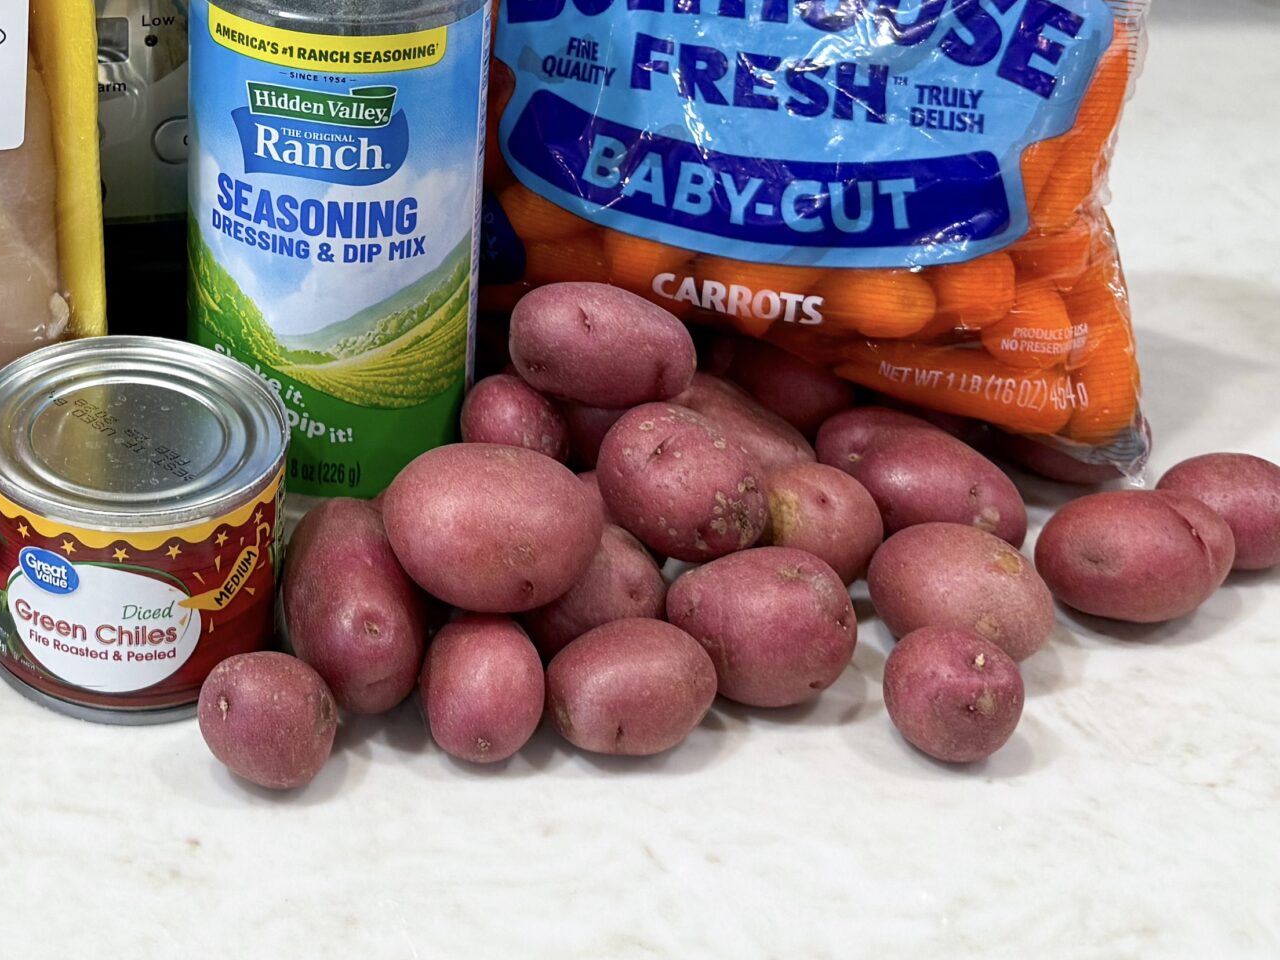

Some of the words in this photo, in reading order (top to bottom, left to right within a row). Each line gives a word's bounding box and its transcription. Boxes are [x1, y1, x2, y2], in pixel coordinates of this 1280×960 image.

[141, 15, 175, 27] Low
[215, 22, 279, 55] AMERICA'S
[281, 45, 294, 58] #1
[297, 48, 350, 64] RANCH
[566, 36, 599, 62] FINE
[289, 71, 319, 82] SINCE
[323, 75, 347, 84] 1954
[542, 55, 616, 87] QUALITY
[630, 32, 889, 125] FRESH
[97, 82, 127, 93] arm
[914, 84, 985, 110] TRULY
[253, 89, 325, 116] Hidden
[281, 127, 302, 138] THE
[303, 131, 355, 143] ORIGINAL
[909, 107, 985, 135] DELISH
[253, 122, 386, 171] Ranch
[581, 134, 917, 234] BABY-CUT
[217, 172, 418, 240] SEASONING
[212, 208, 310, 260] DRESSING
[317, 243, 334, 263] &
[343, 243, 382, 263] DIP
[389, 235, 427, 261] MIX
[651, 272, 824, 325] CARROTS
[1000, 338, 1019, 351] NO
[1012, 327, 1063, 340] PRODUCE
[285, 384, 306, 408] it.
[878, 360, 911, 384] NET
[914, 368, 943, 388] WT
[946, 372, 955, 389] 1
[959, 373, 982, 394] LB
[985, 374, 1017, 405] (16
[1017, 378, 1048, 412] OZ)
[286, 407, 326, 439] Dip
[329, 428, 353, 443] it!
[301, 464, 315, 481] oz
[318, 460, 345, 485] (226
[25, 552, 68, 580] Great
[35, 569, 68, 589] Value
[214, 550, 257, 606] MEDIUM
[15, 598, 87, 641] Green
[95, 624, 177, 647] Chiles
[121, 600, 175, 621] Diced
[29, 629, 50, 647] Fire
[53, 640, 109, 661] Roasted
[112, 650, 122, 661] &
[127, 647, 177, 662] Peeled
